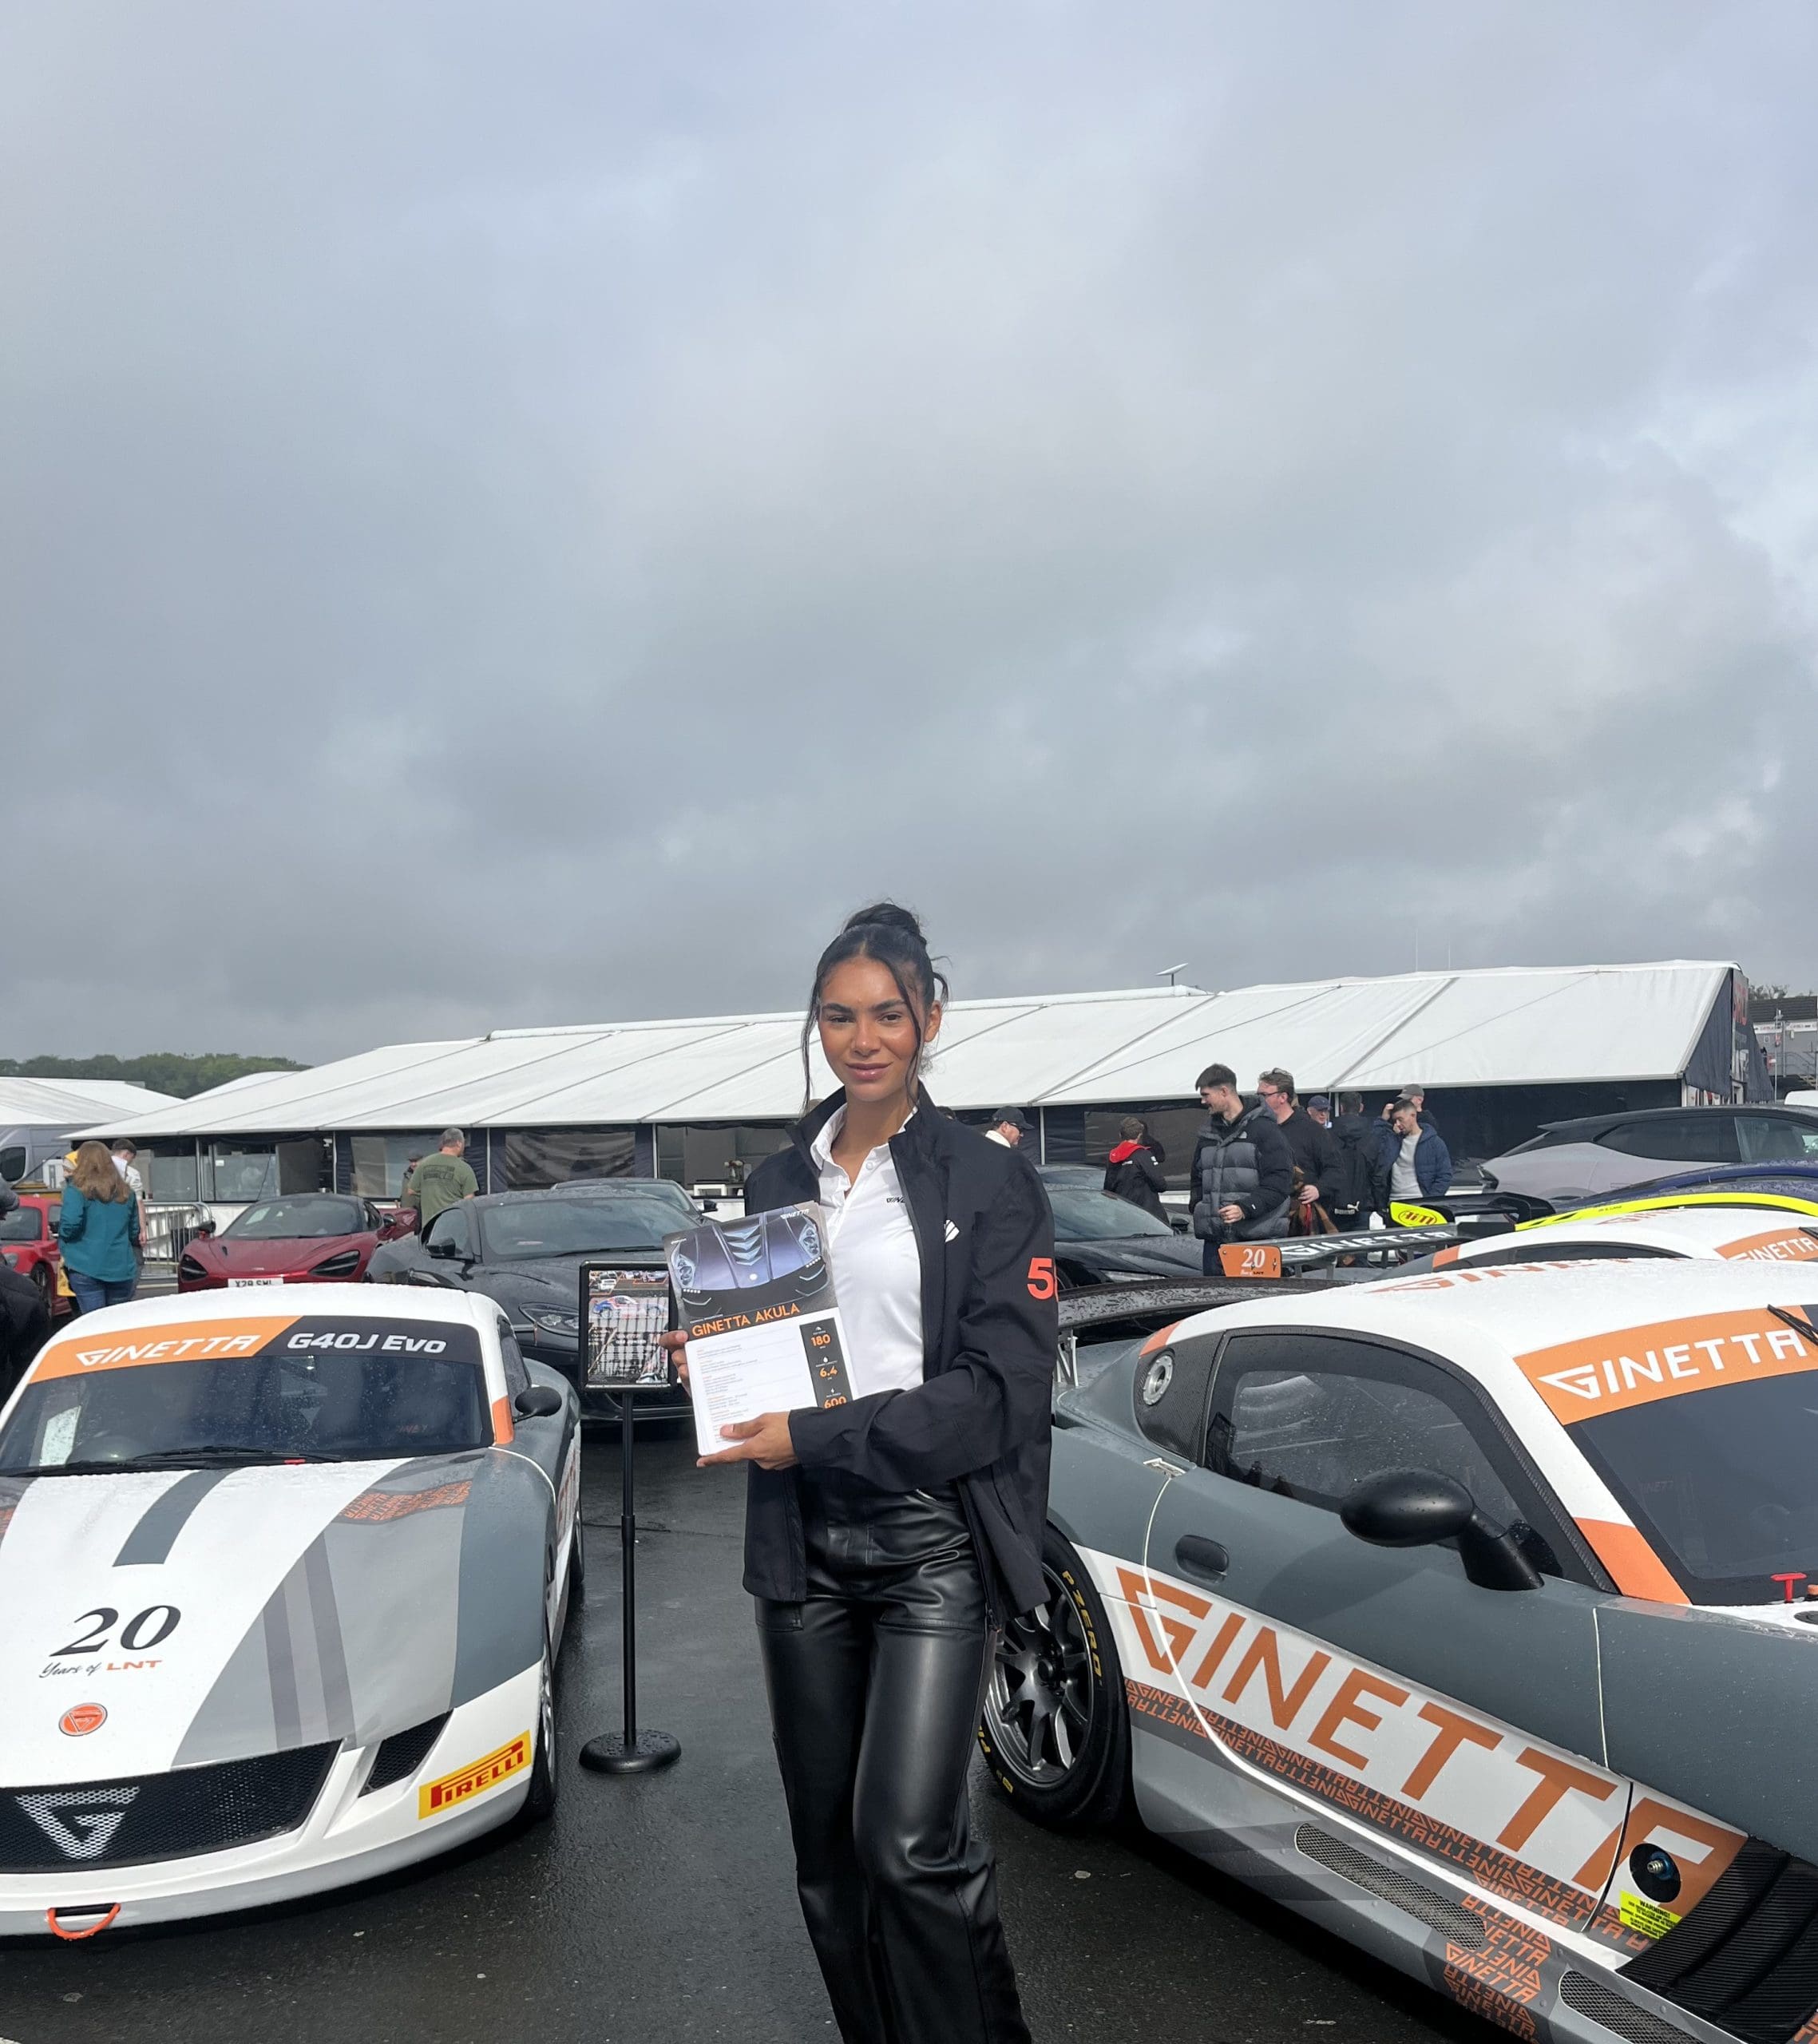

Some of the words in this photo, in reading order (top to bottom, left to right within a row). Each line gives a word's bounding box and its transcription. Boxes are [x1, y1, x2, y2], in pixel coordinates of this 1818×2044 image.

[1028, 1258, 1058, 1301] 5
[1241, 1248, 1265, 1269] 20
[691, 1314, 751, 1337] GINETTA
[755, 1302, 800, 1323] AKULA
[810, 1333, 831, 1347] 180
[76, 1334, 262, 1366] GINETTA
[287, 1333, 379, 1349] G40J
[819, 1365, 838, 1378] 6.4
[1536, 1328, 1808, 1400] GINETTA
[49, 1605, 181, 1657] 20
[1073, 1589, 1102, 1678] ZERO
[39, 1662, 81, 1678] Years
[85, 1662, 101, 1676] of
[106, 1660, 162, 1670] LNT
[1115, 1565, 1750, 1919] GINETTA
[1206, 1725, 1277, 1768] INETTA
[430, 1741, 524, 1809] PIRELLI
[1483, 1920, 1549, 1967] NETTA
[1446, 1943, 1539, 2004] GINETTA
[1475, 1946, 1542, 1991] GINET
